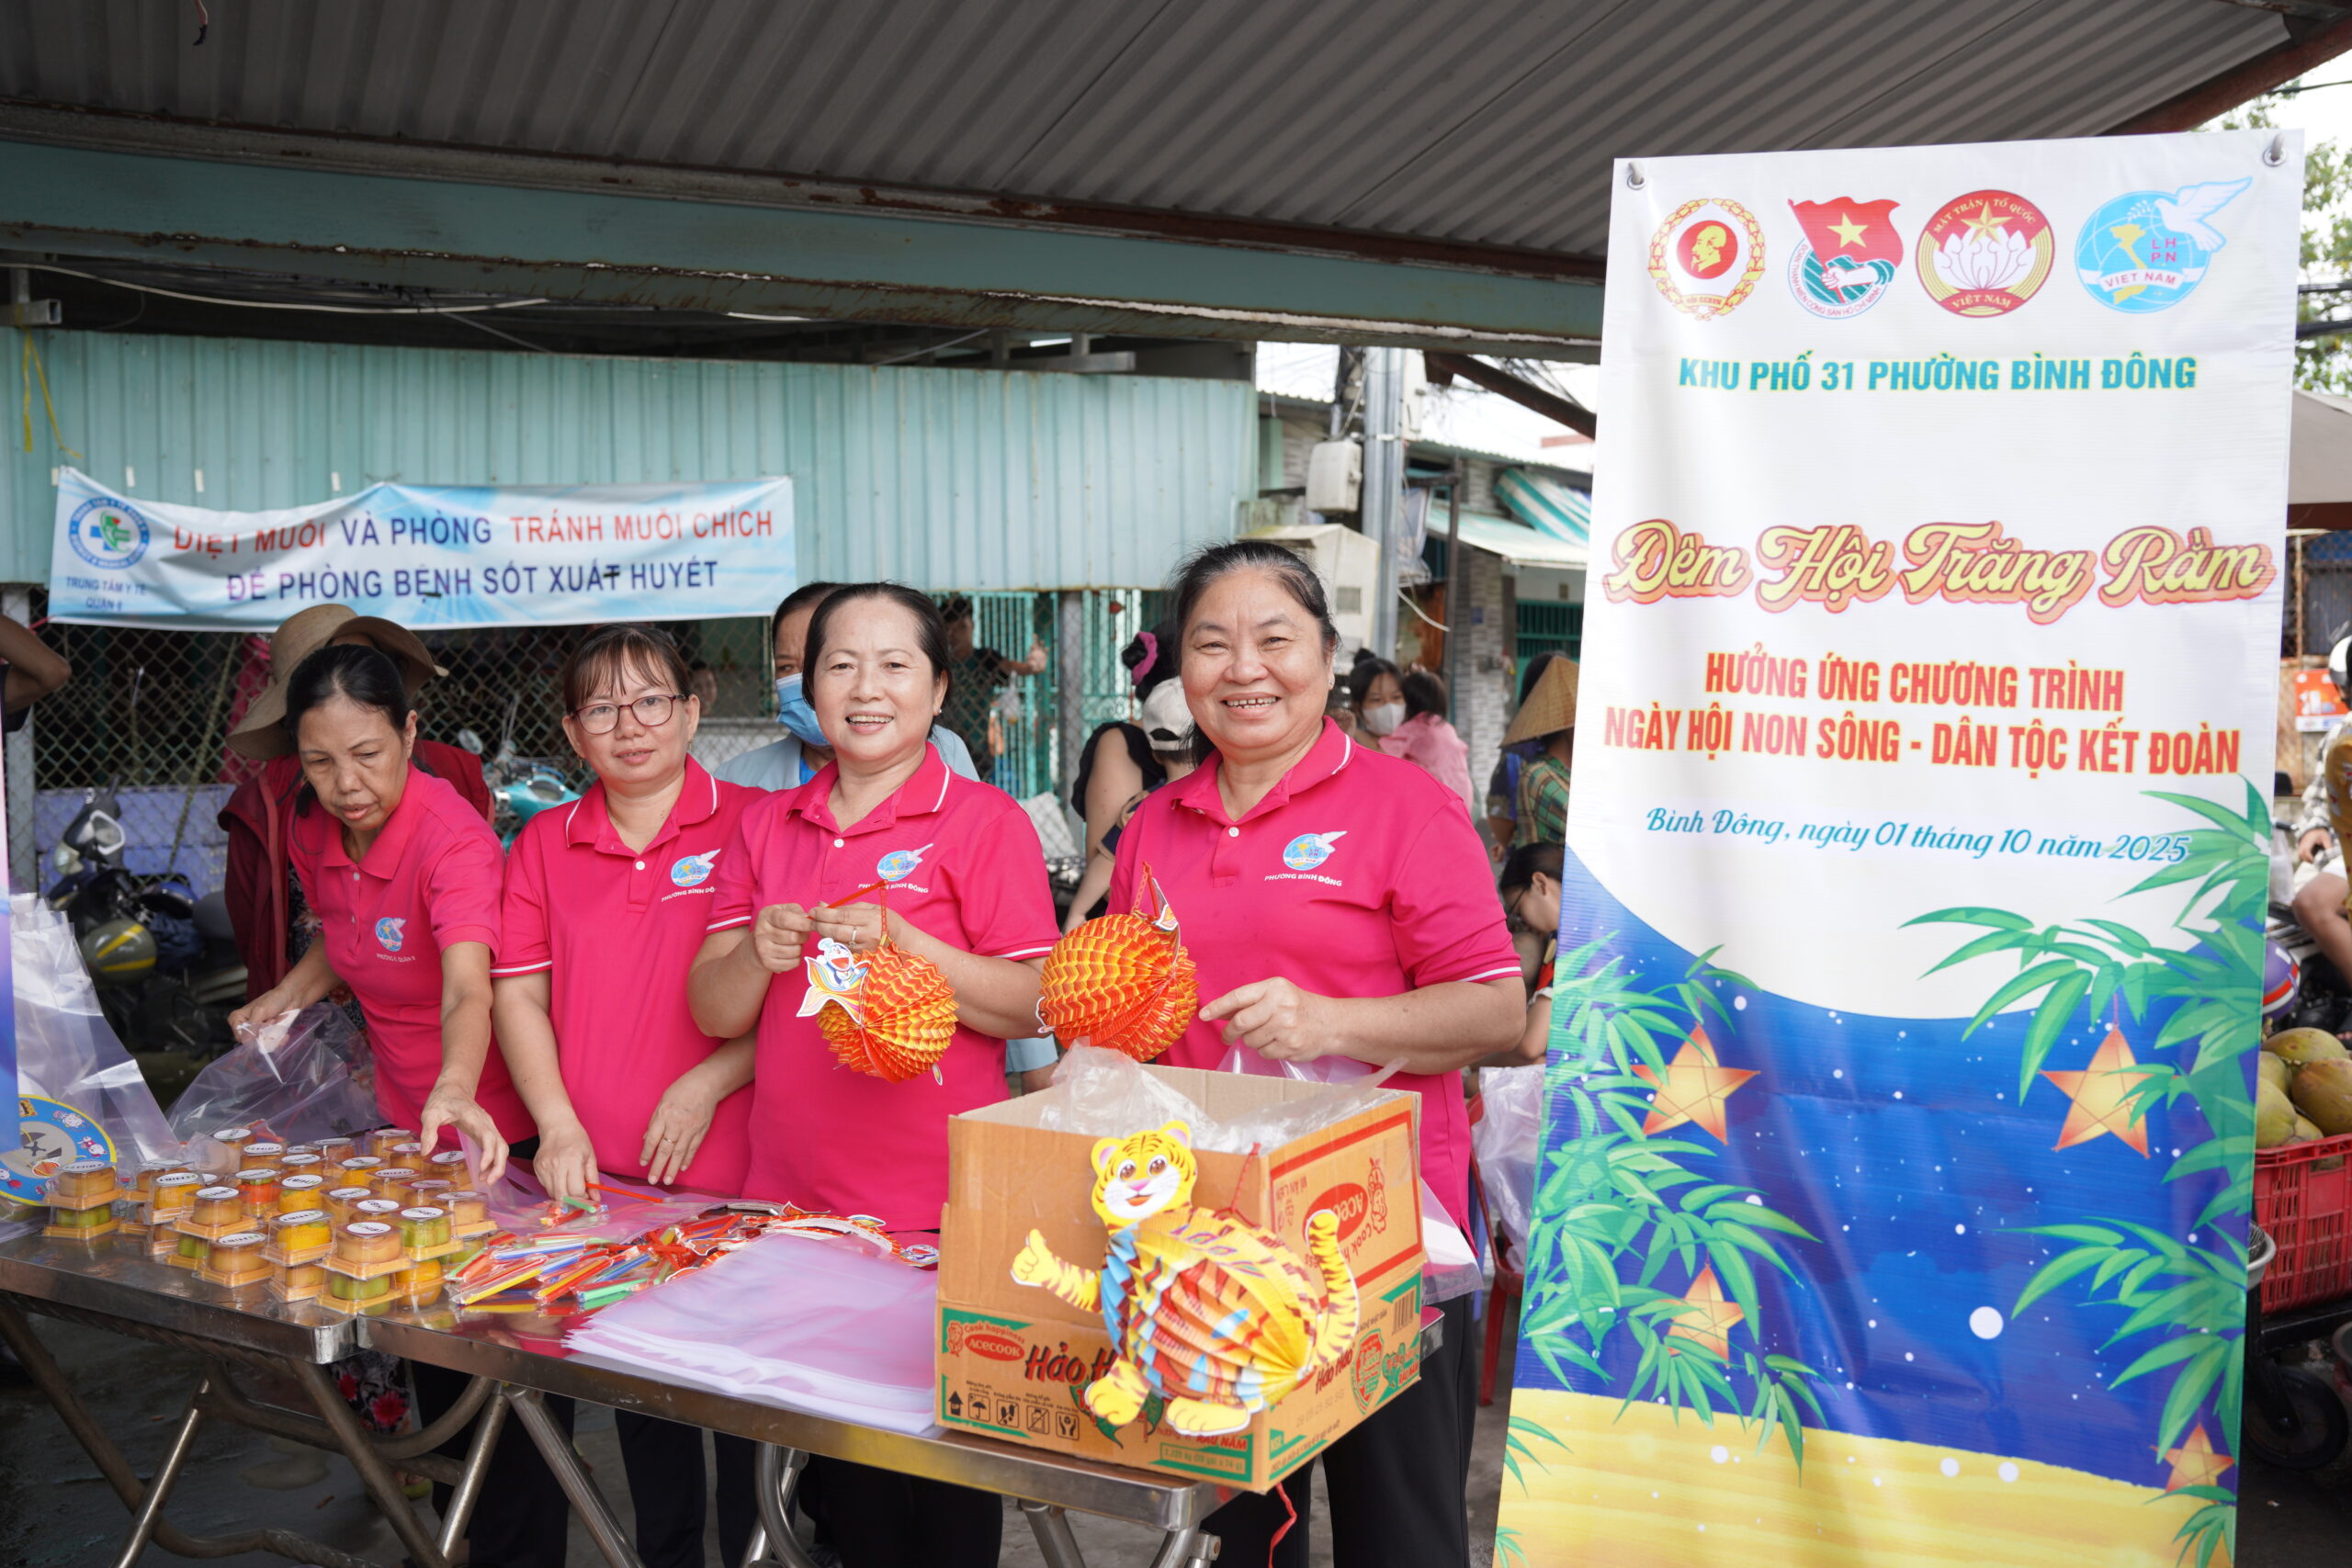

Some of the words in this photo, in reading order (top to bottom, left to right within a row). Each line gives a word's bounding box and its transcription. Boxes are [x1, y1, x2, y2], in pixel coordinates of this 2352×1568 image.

[2143, 271, 2177, 286] NAM
[1984, 294, 2012, 309] NAM
[1679, 356, 1740, 390] KHU
[1749, 349, 1814, 391] PHỐ
[1821, 361, 1855, 391] 31
[1868, 353, 2000, 391] PHƯỜNG
[2010, 353, 2091, 390] BÌNH
[2101, 350, 2197, 390] ĐÔNG
[341, 511, 379, 547] VÀ
[390, 509, 492, 547] PHÒNG
[510, 508, 603, 544] TRÁNH
[693, 503, 773, 539] CHÍCH
[279, 563, 383, 601] PHÒNG
[394, 563, 470, 604] BỆNH
[482, 558, 537, 595] SỐT
[1603, 518, 1753, 604] Đêm
[1756, 525, 1899, 614] Hội
[1898, 521, 2098, 625] Trăng
[2098, 525, 2277, 607] Rằm
[1705, 641, 1807, 698] HƯỞNG
[1817, 652, 1881, 702] ỨNG
[1889, 660, 2018, 707] CHƯƠNG
[2029, 660, 2124, 712] TRÌNH
[1604, 702, 1681, 751] NGÀY
[1687, 702, 1734, 761] HỘI
[1742, 712, 1808, 757] NON
[1816, 710, 1901, 762] SÔNG
[1931, 716, 1998, 767] DÂN
[2008, 718, 2068, 779] TỘC
[2078, 716, 2140, 773] KẾT
[2148, 722, 2240, 775] ĐOÀN
[1645, 807, 1705, 834] Bình
[1711, 808, 1791, 845] Đông,
[1797, 820, 1871, 852] ngày
[1874, 821, 1910, 847] 01
[1910, 825, 1994, 859] tháng
[1998, 828, 2032, 854] 10
[2036, 834, 2104, 859] năm
[2108, 834, 2192, 863] 2025
[907, 882, 930, 893] ĐÔNG
[1264, 873, 1297, 881] PHƯỜNG
[1297, 872, 1317, 881] BÌNH
[1317, 876, 1343, 886] ĐÔNG
[1024, 1341, 1087, 1385] Hảo
